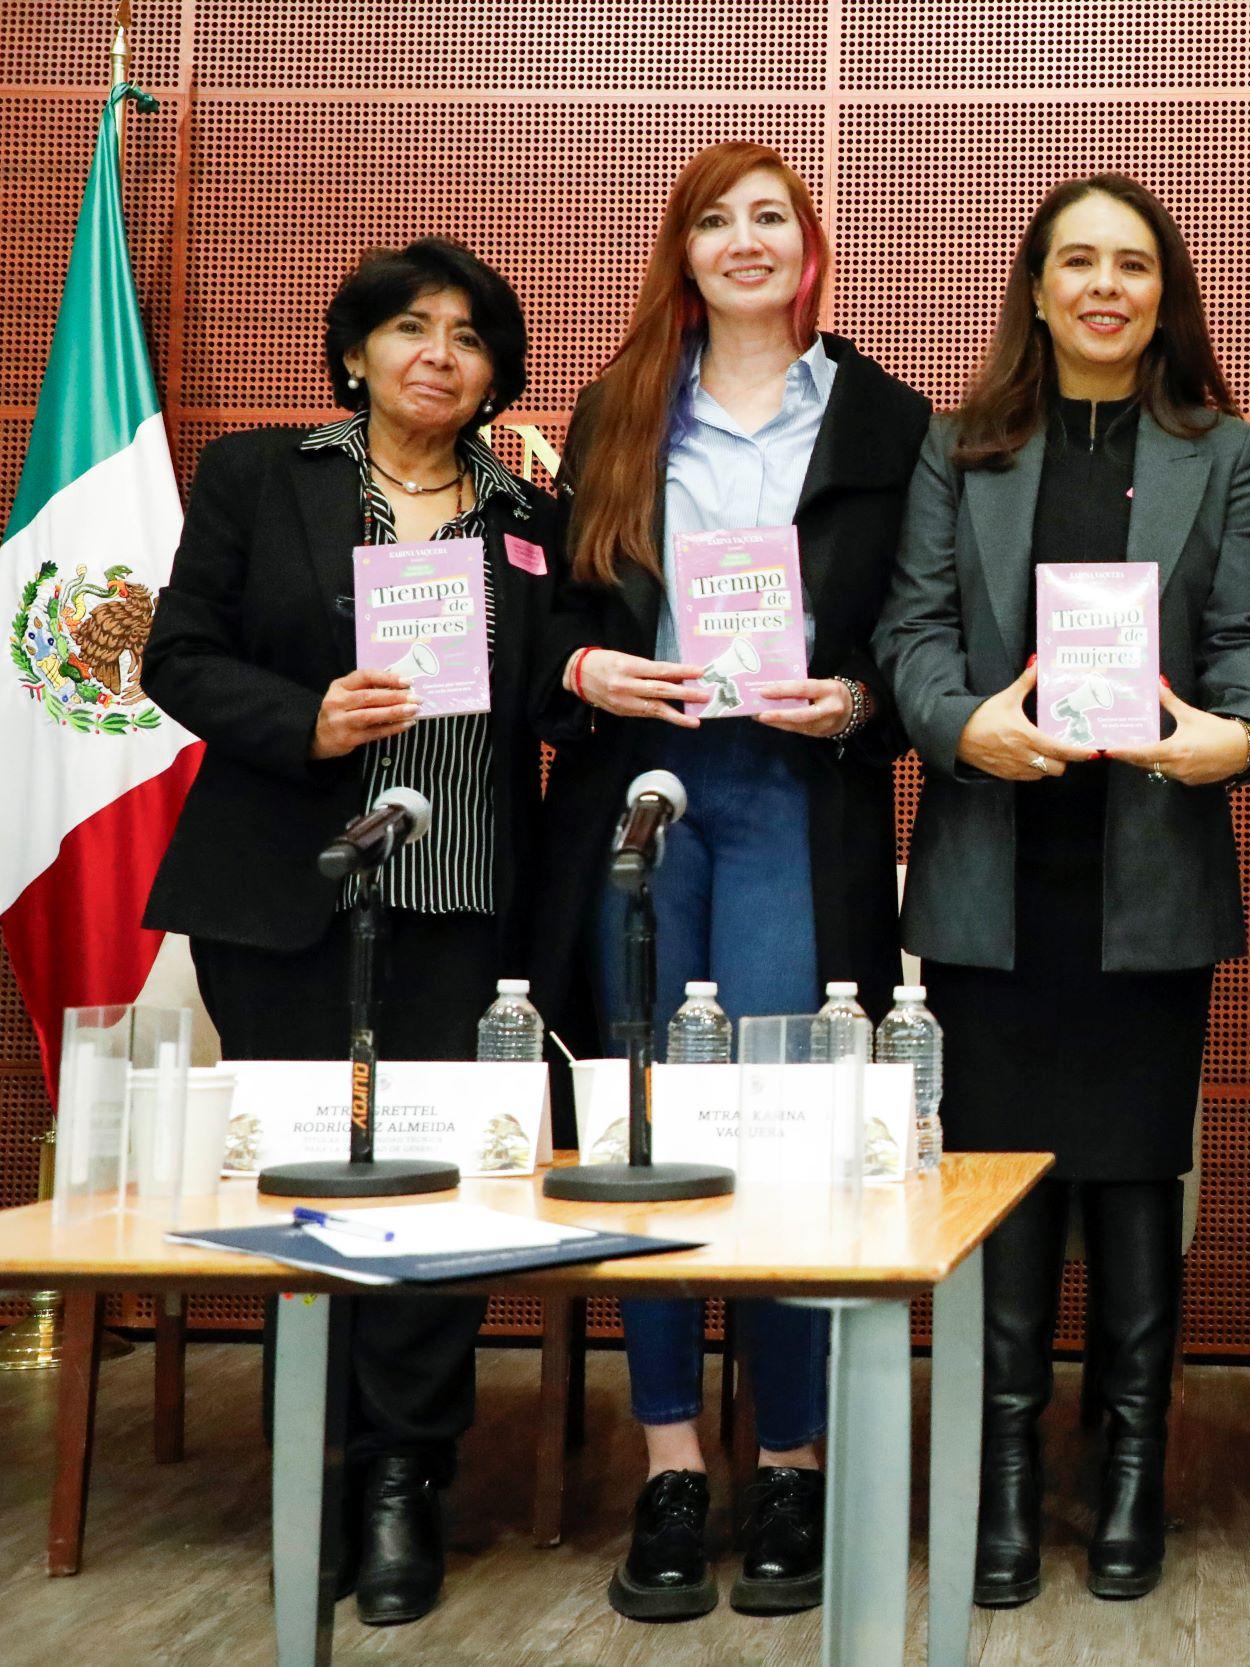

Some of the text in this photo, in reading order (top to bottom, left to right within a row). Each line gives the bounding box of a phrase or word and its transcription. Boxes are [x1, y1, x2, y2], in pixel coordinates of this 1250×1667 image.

[694, 572, 781, 595] Tiempo
[374, 581, 465, 605] Tiempo
[767, 592, 786, 606] de
[449, 599, 469, 613] de
[704, 613, 782, 633] mujeres
[1054, 609, 1140, 628] Tiempo
[382, 620, 464, 639] mujeres
[1124, 629, 1144, 642] de
[316, 1105, 352, 1117] MTR
[388, 1122, 455, 1133] ALMEIDA
